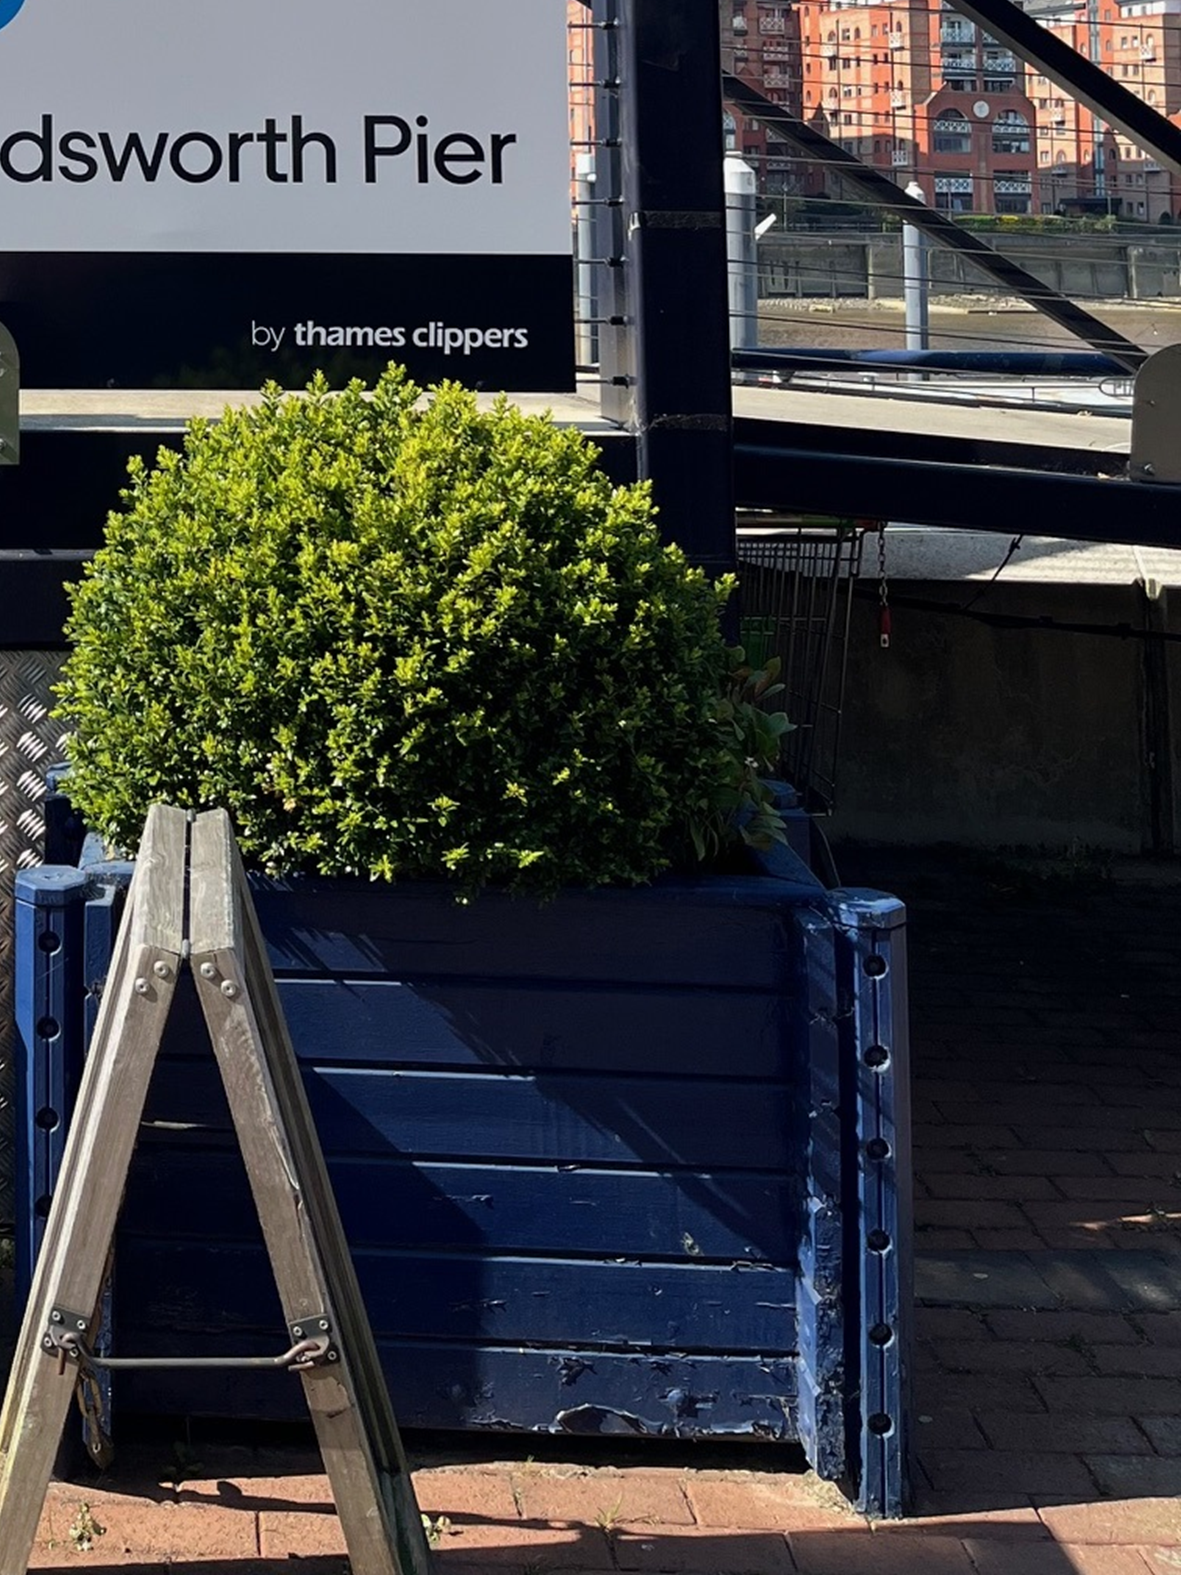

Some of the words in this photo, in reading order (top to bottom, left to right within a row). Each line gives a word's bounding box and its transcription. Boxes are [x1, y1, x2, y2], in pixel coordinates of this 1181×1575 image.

[364, 115, 517, 185] Pier
[251, 320, 286, 352] by
[293, 320, 406, 347] thames
[412, 321, 529, 355] clippers
